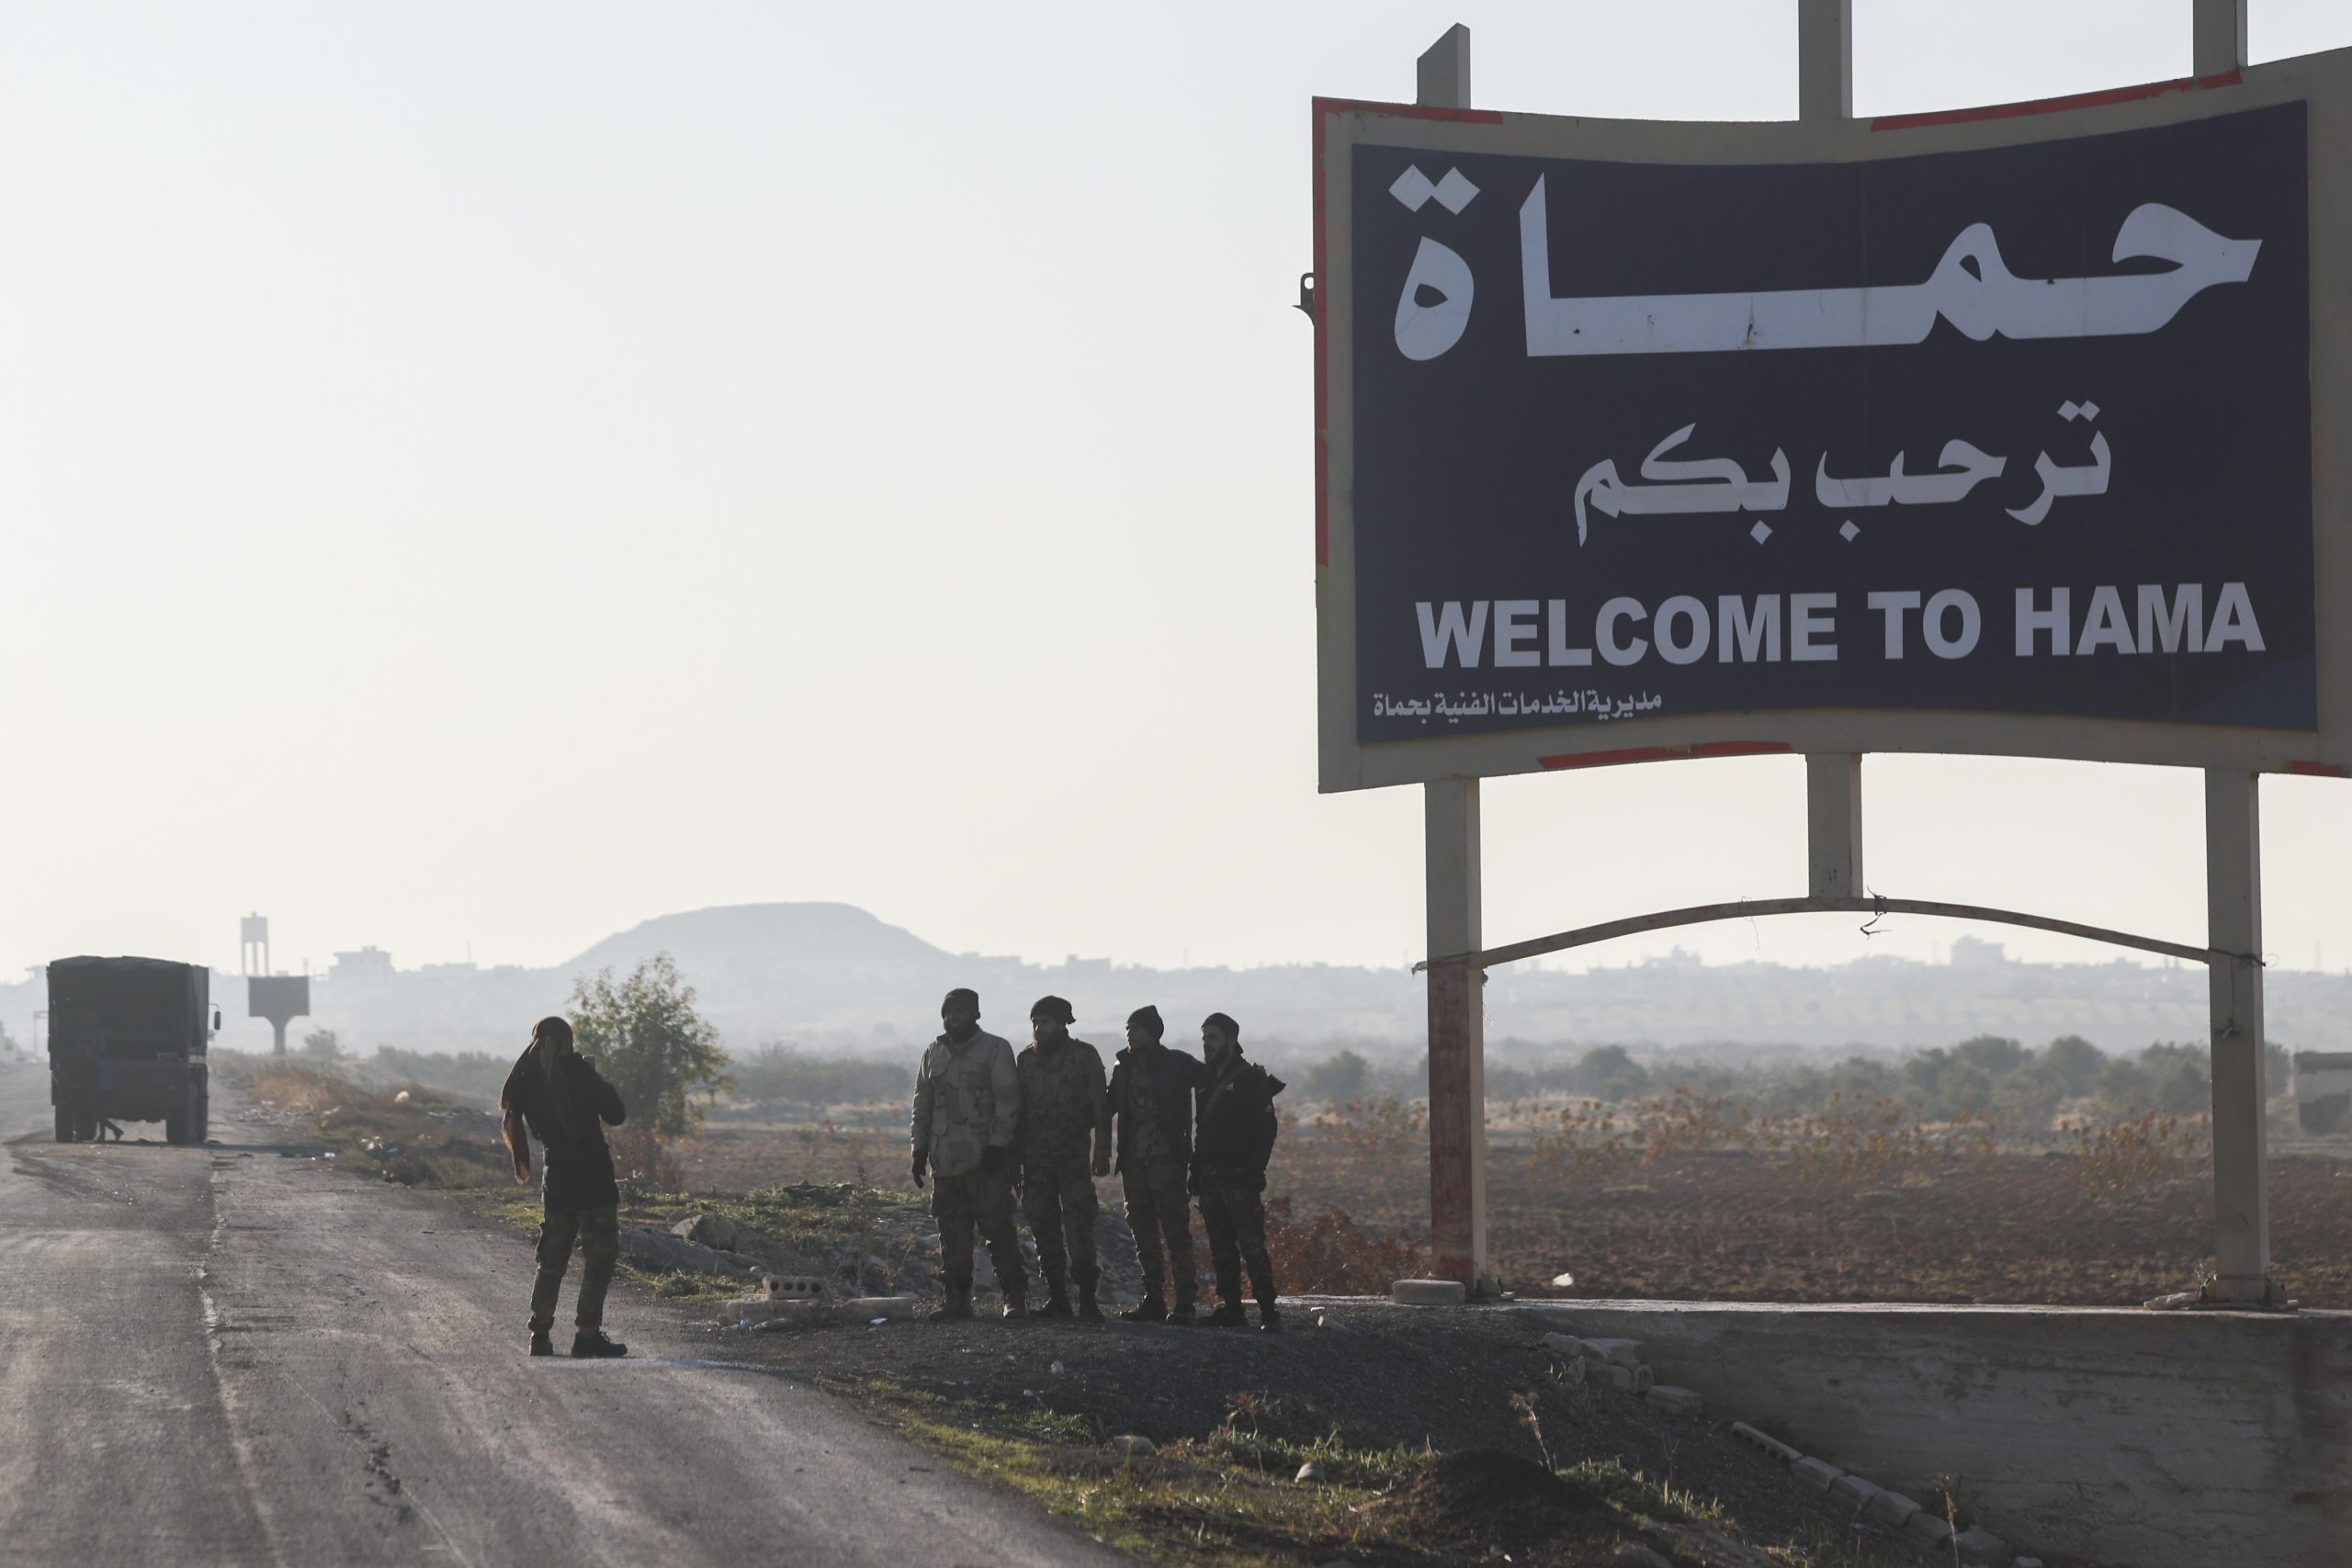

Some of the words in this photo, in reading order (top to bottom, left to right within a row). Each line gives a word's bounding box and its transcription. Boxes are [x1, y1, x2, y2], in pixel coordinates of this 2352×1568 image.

[1387, 164, 2262, 362] حماة
[1574, 423, 1791, 547] بكم
[1815, 400, 2111, 544] ترحب
[1415, 592, 1838, 668] WELCOME
[1868, 589, 1981, 660] TO
[2015, 582, 2266, 656] HAMA
[1373, 692, 1431, 725] بحماة
[1434, 691, 1497, 724] الفنية
[1498, 689, 1586, 716] الخدمات
[1587, 689, 1662, 721] مديرية
